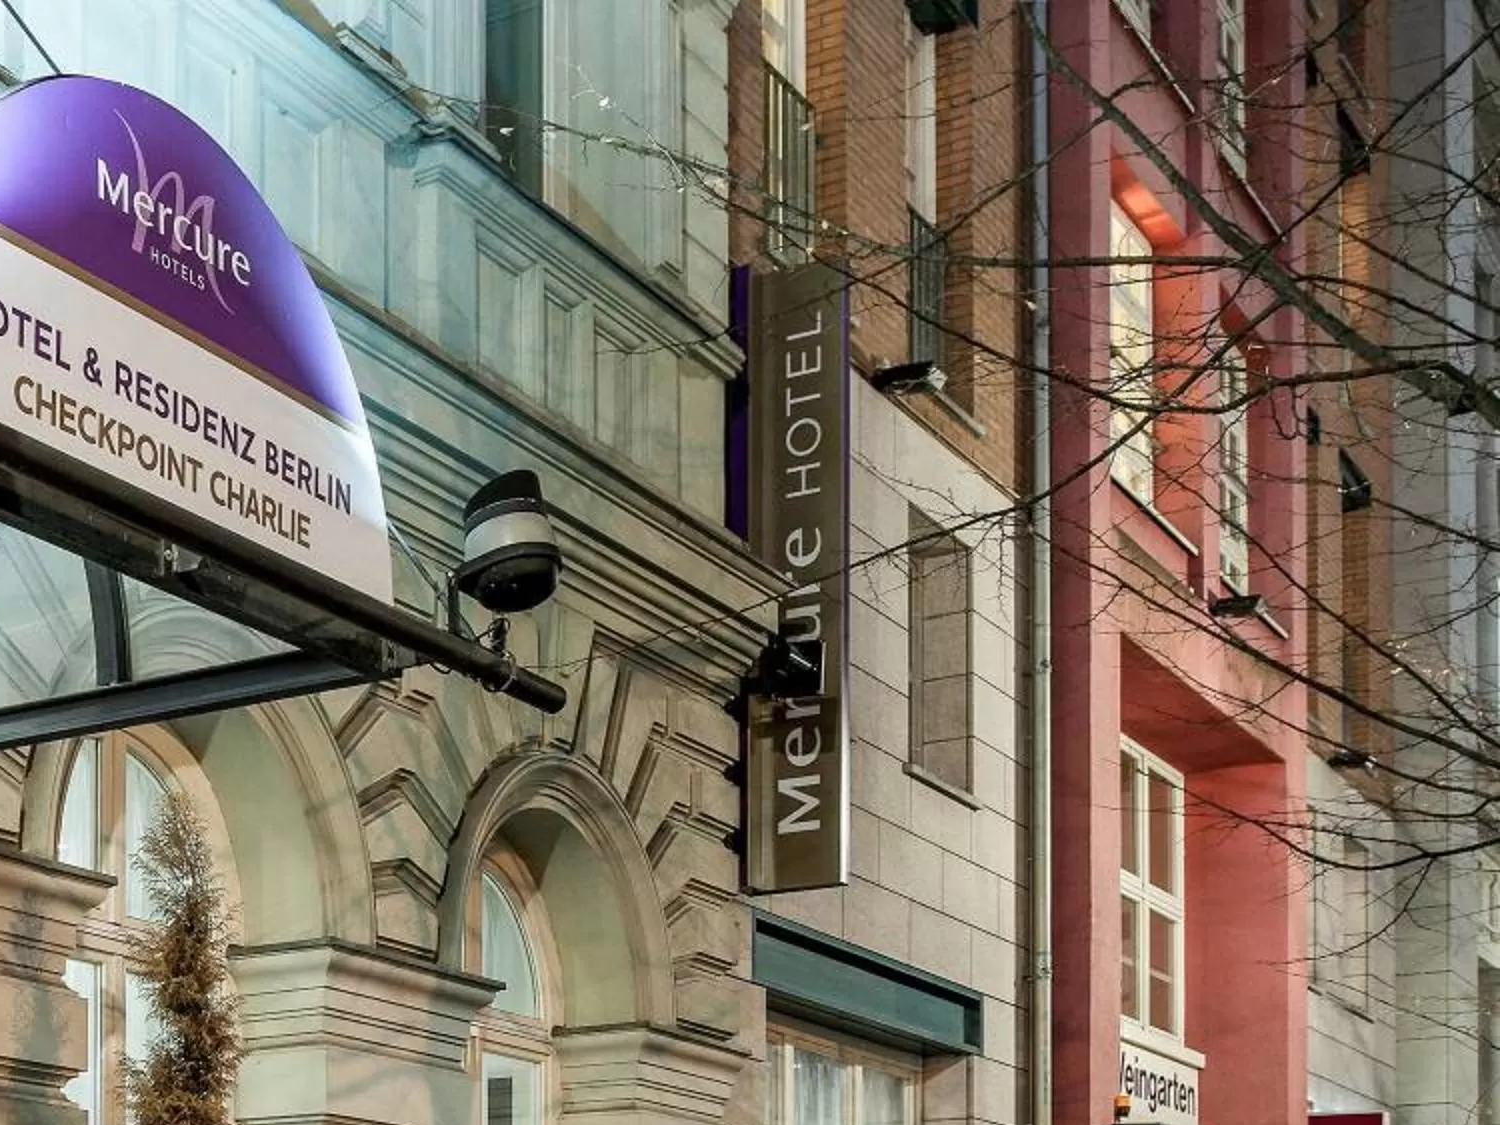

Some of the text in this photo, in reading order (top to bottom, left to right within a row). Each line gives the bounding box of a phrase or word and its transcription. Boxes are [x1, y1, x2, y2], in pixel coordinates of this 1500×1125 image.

[97, 158, 251, 287] Mercure
[149, 246, 206, 291] HOTELS
[13, 375, 312, 550] CHECKPOINT CHARLIE
[83, 347, 103, 388] &
[114, 359, 256, 465] RESIDENZ
[265, 440, 352, 516] BERLIN
[777, 311, 823, 835] Merure HOTEL
